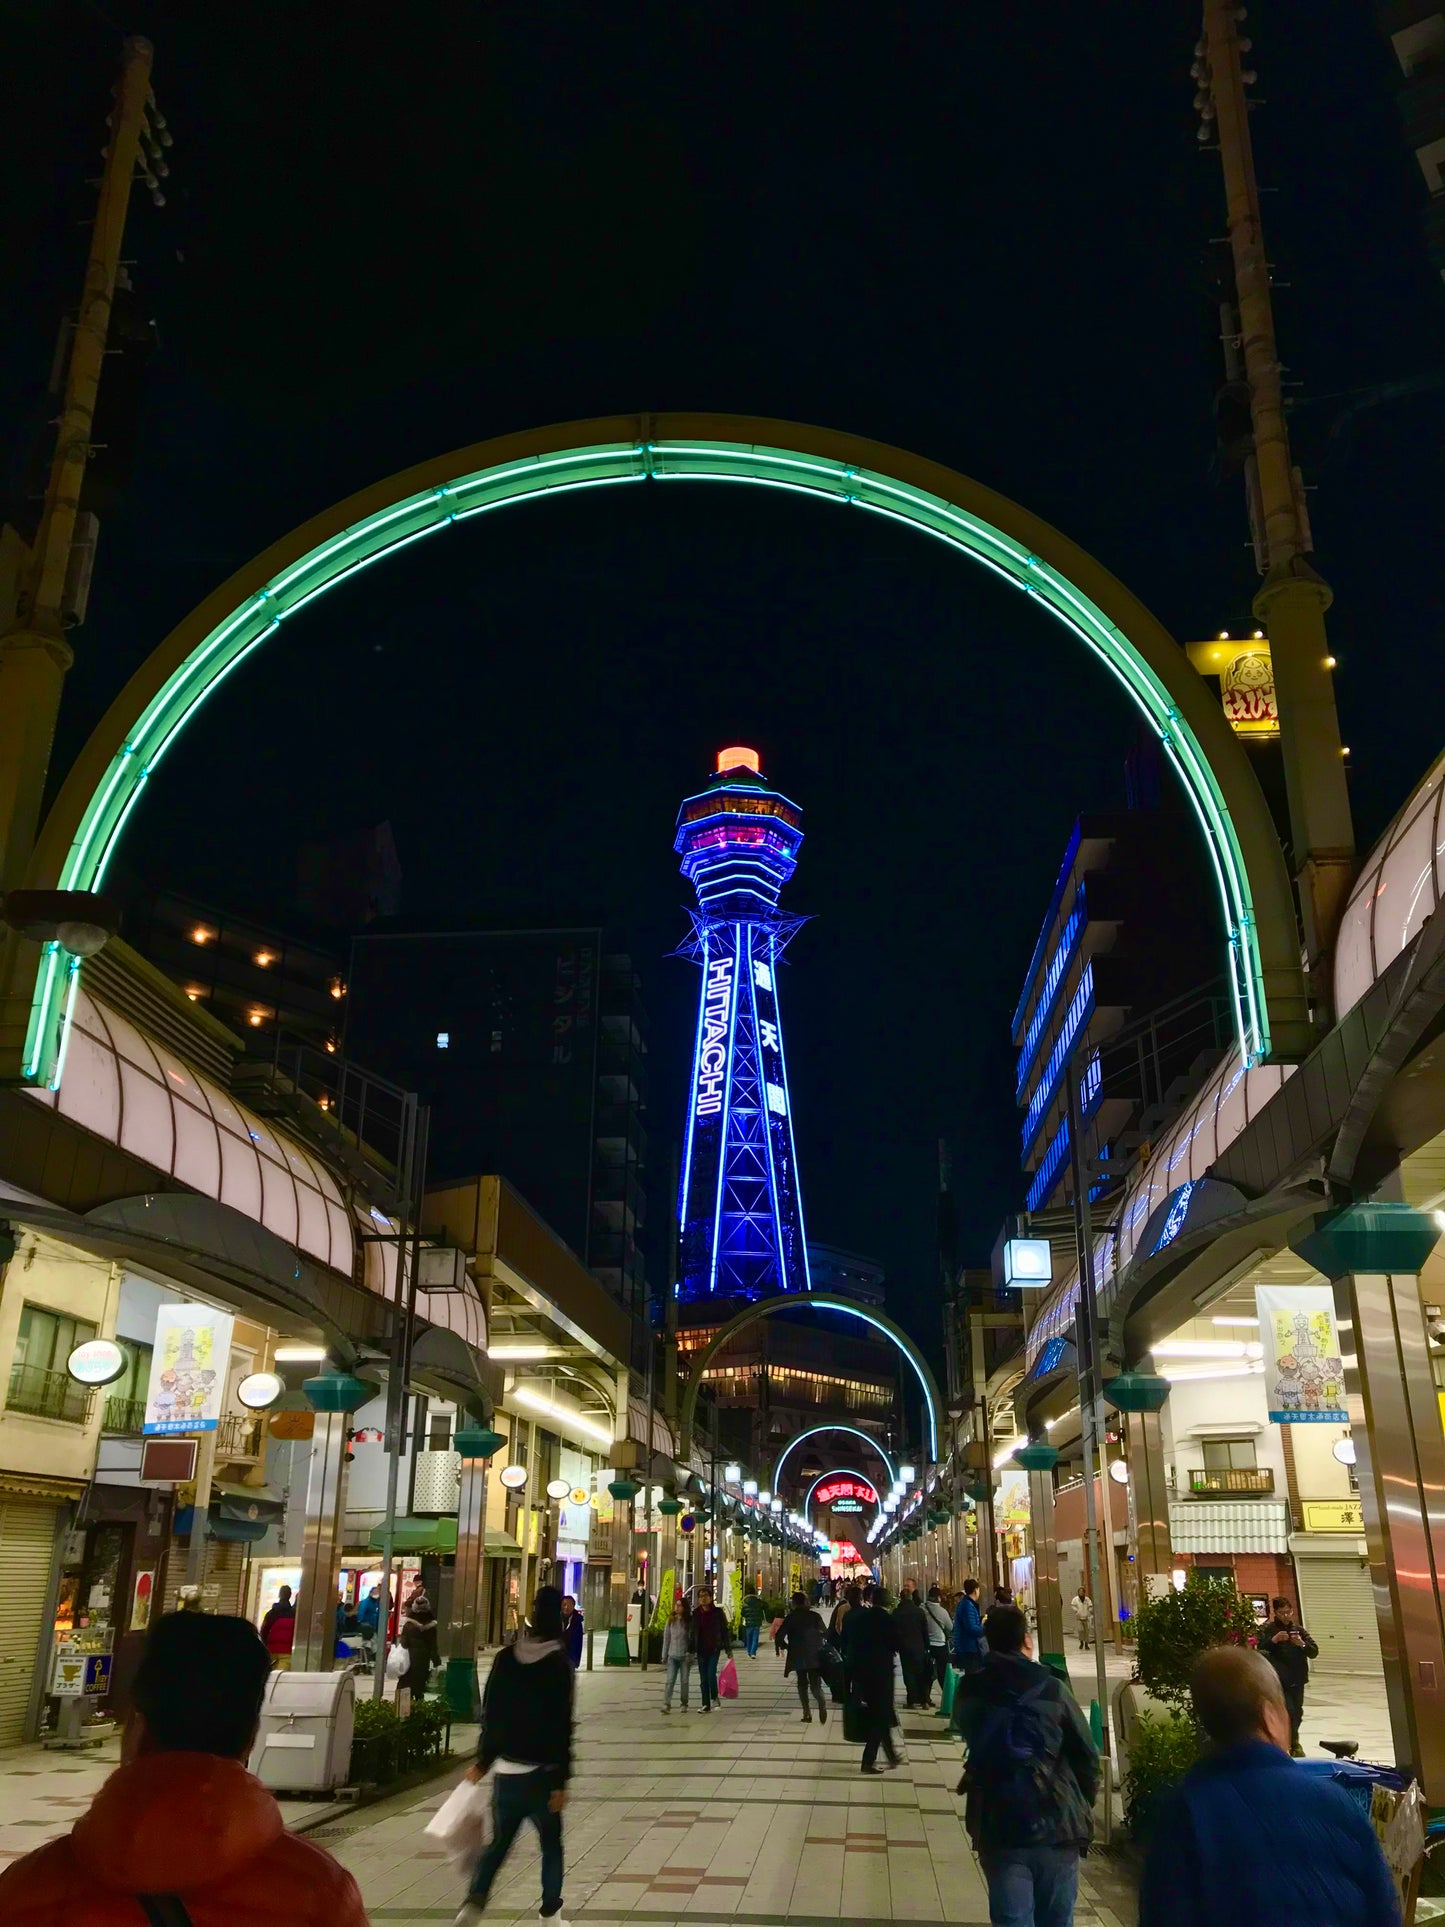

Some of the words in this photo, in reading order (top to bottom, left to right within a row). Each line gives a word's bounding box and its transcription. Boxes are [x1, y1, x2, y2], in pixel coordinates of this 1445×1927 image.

[697, 957, 733, 1116] HITACHI
[753, 959, 787, 1117] 通天閣
